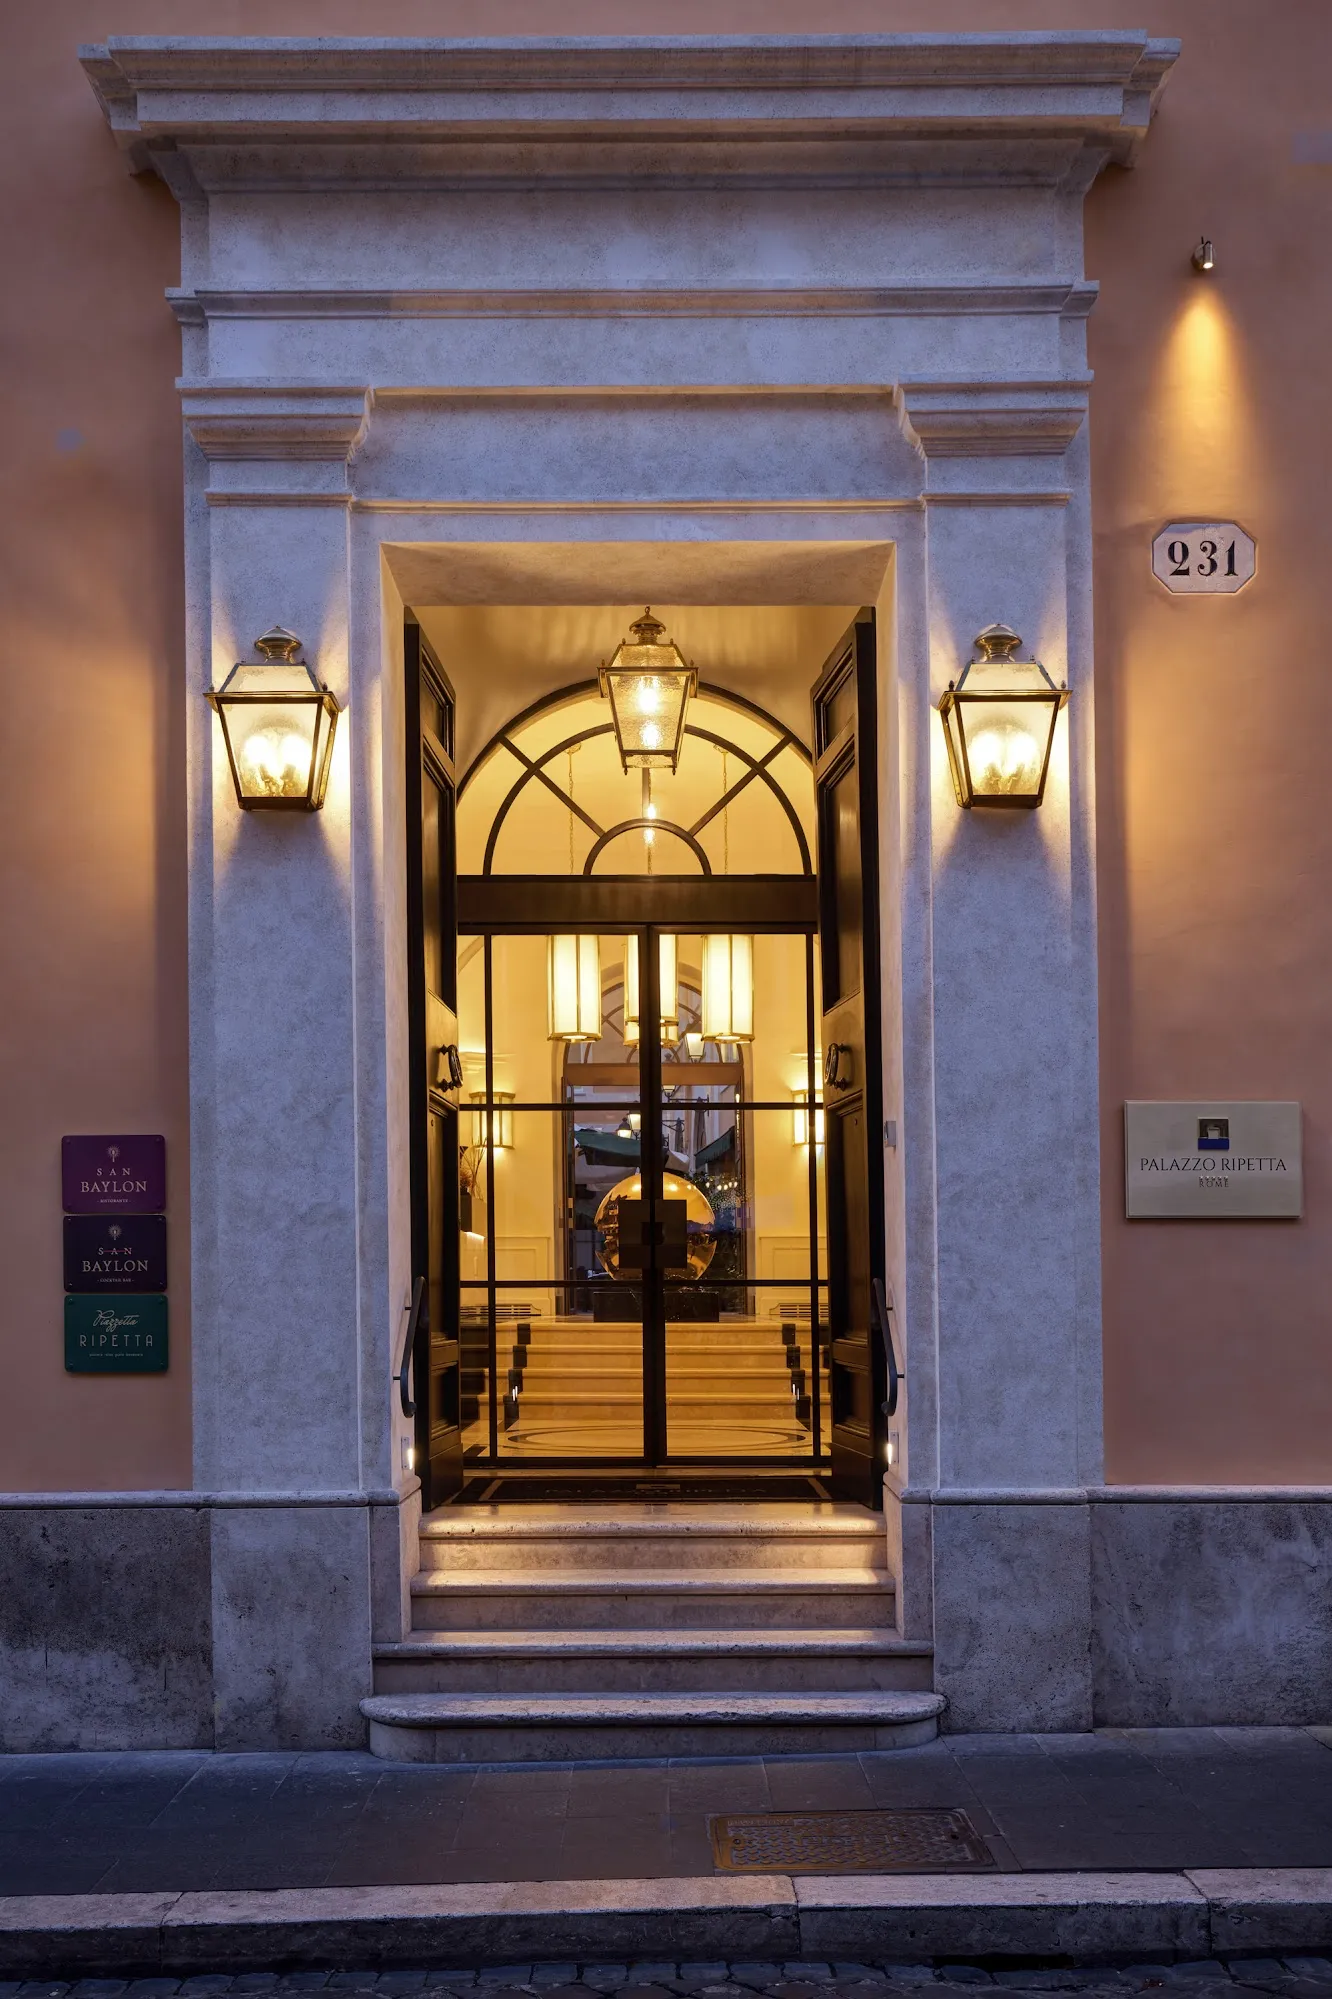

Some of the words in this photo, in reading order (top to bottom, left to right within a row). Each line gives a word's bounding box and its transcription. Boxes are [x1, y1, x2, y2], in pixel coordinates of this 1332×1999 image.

[1167, 540, 1239, 577] 231
[1140, 1157, 1216, 1171] PALAZZO
[1221, 1157, 1287, 1171] RIPETTA
[96, 1167, 132, 1177] SAN
[80, 1181, 148, 1193] BAYLON
[1199, 1180, 1230, 1188] ROME
[98, 1247, 133, 1256] SAN
[82, 1260, 149, 1272] BAYLON
[92, 1309, 140, 1333] Piazzetta
[79, 1334, 154, 1347] RIPETTA
